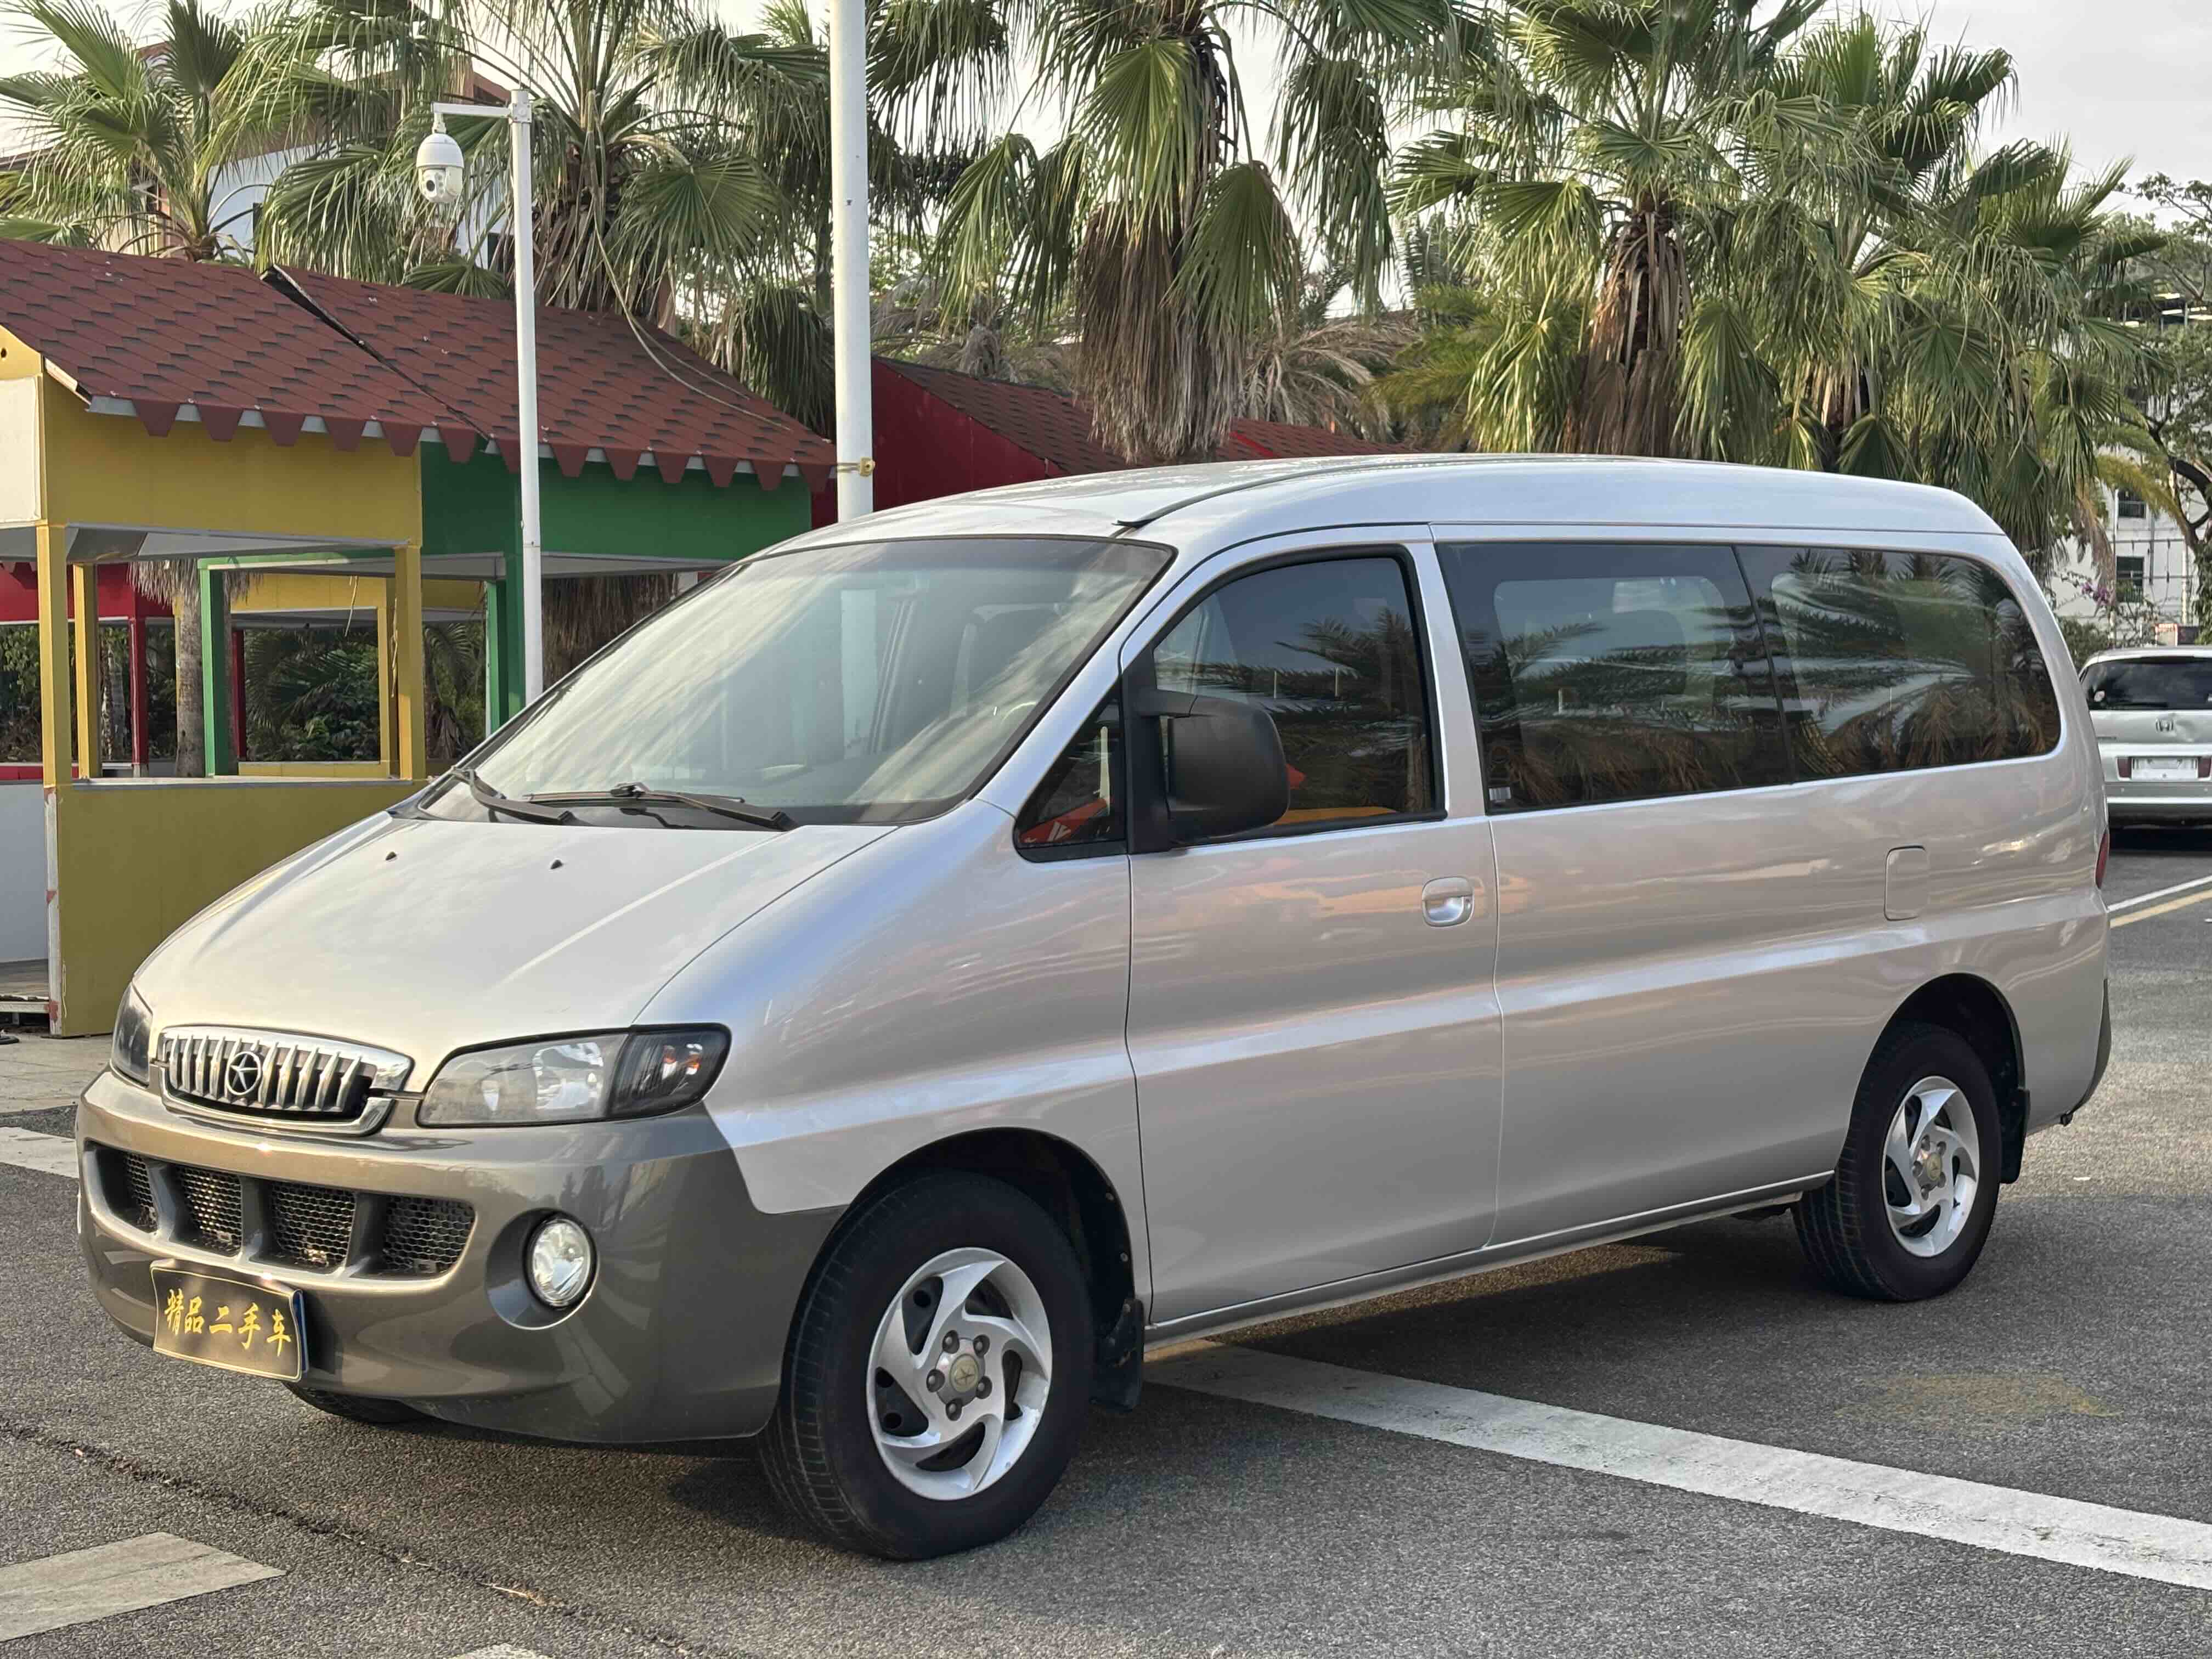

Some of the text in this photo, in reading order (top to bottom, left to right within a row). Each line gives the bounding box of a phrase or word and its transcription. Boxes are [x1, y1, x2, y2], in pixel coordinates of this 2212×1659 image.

[165, 1289, 291, 1356] 精品二手车
